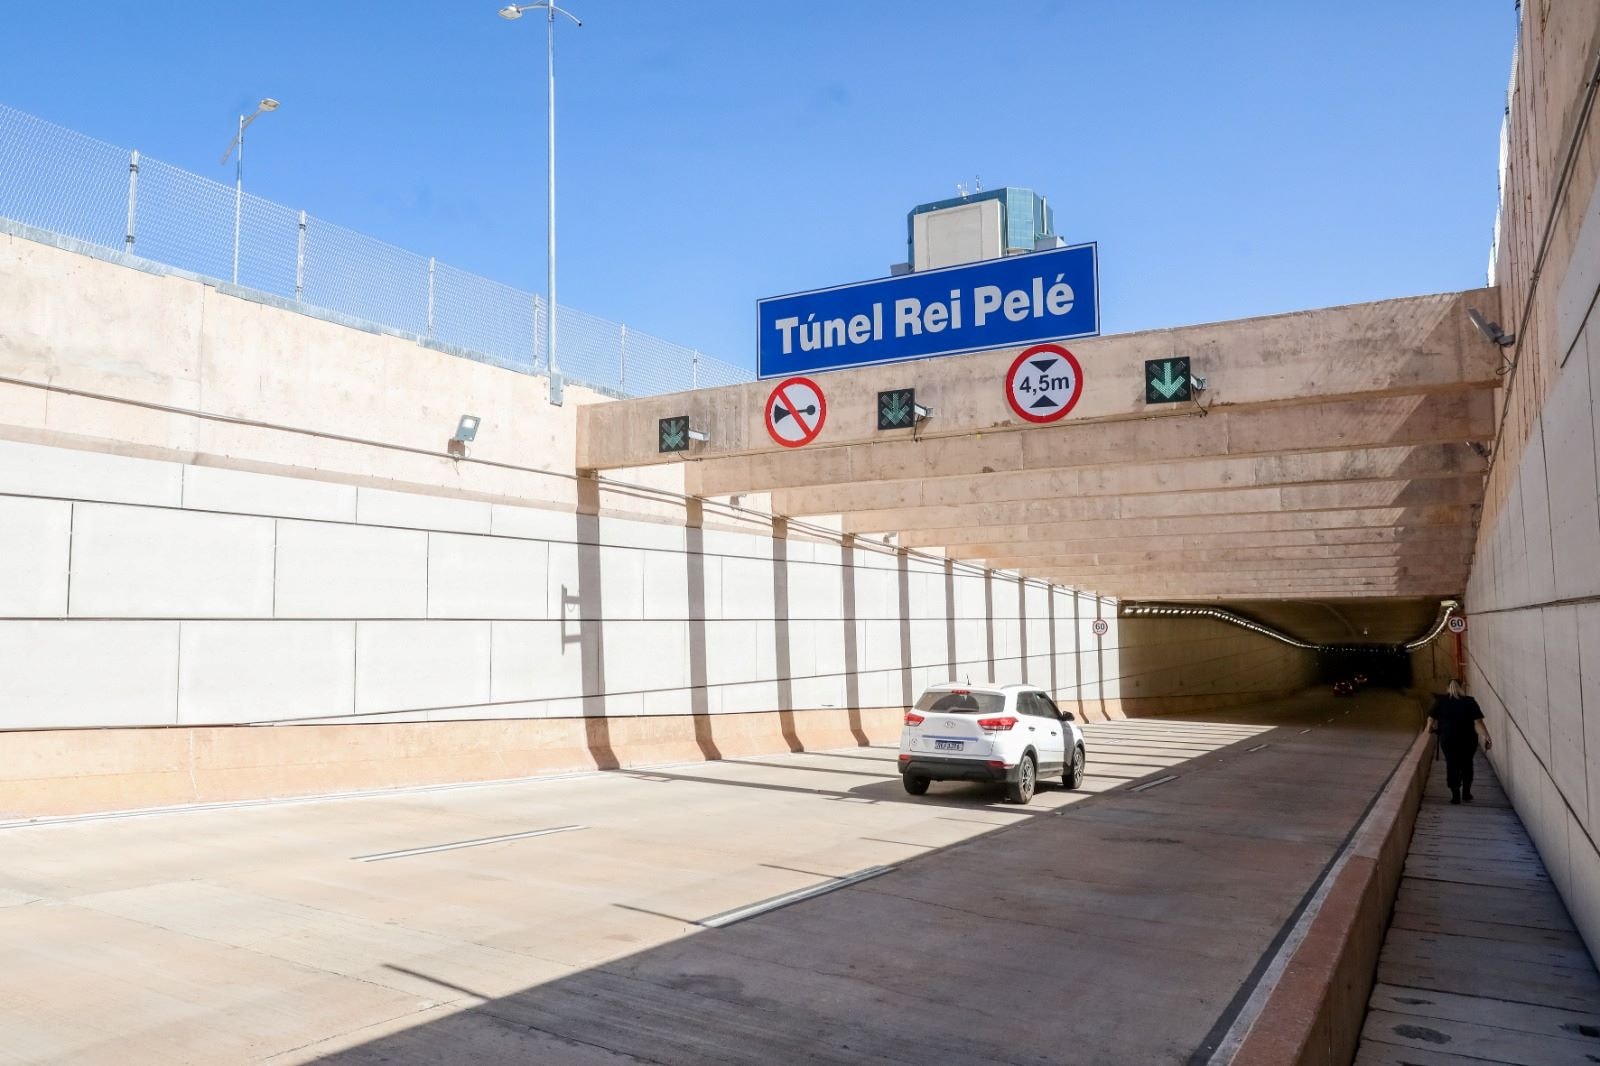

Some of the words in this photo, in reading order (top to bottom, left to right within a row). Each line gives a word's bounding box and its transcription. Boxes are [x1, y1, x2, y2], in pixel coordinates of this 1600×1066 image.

[775, 302, 883, 355] Túnel
[895, 288, 962, 338] Rei
[974, 273, 1075, 327] Pelé
[1019, 374, 1070, 396] 4,5m
[1450, 619, 1463, 627] 60
